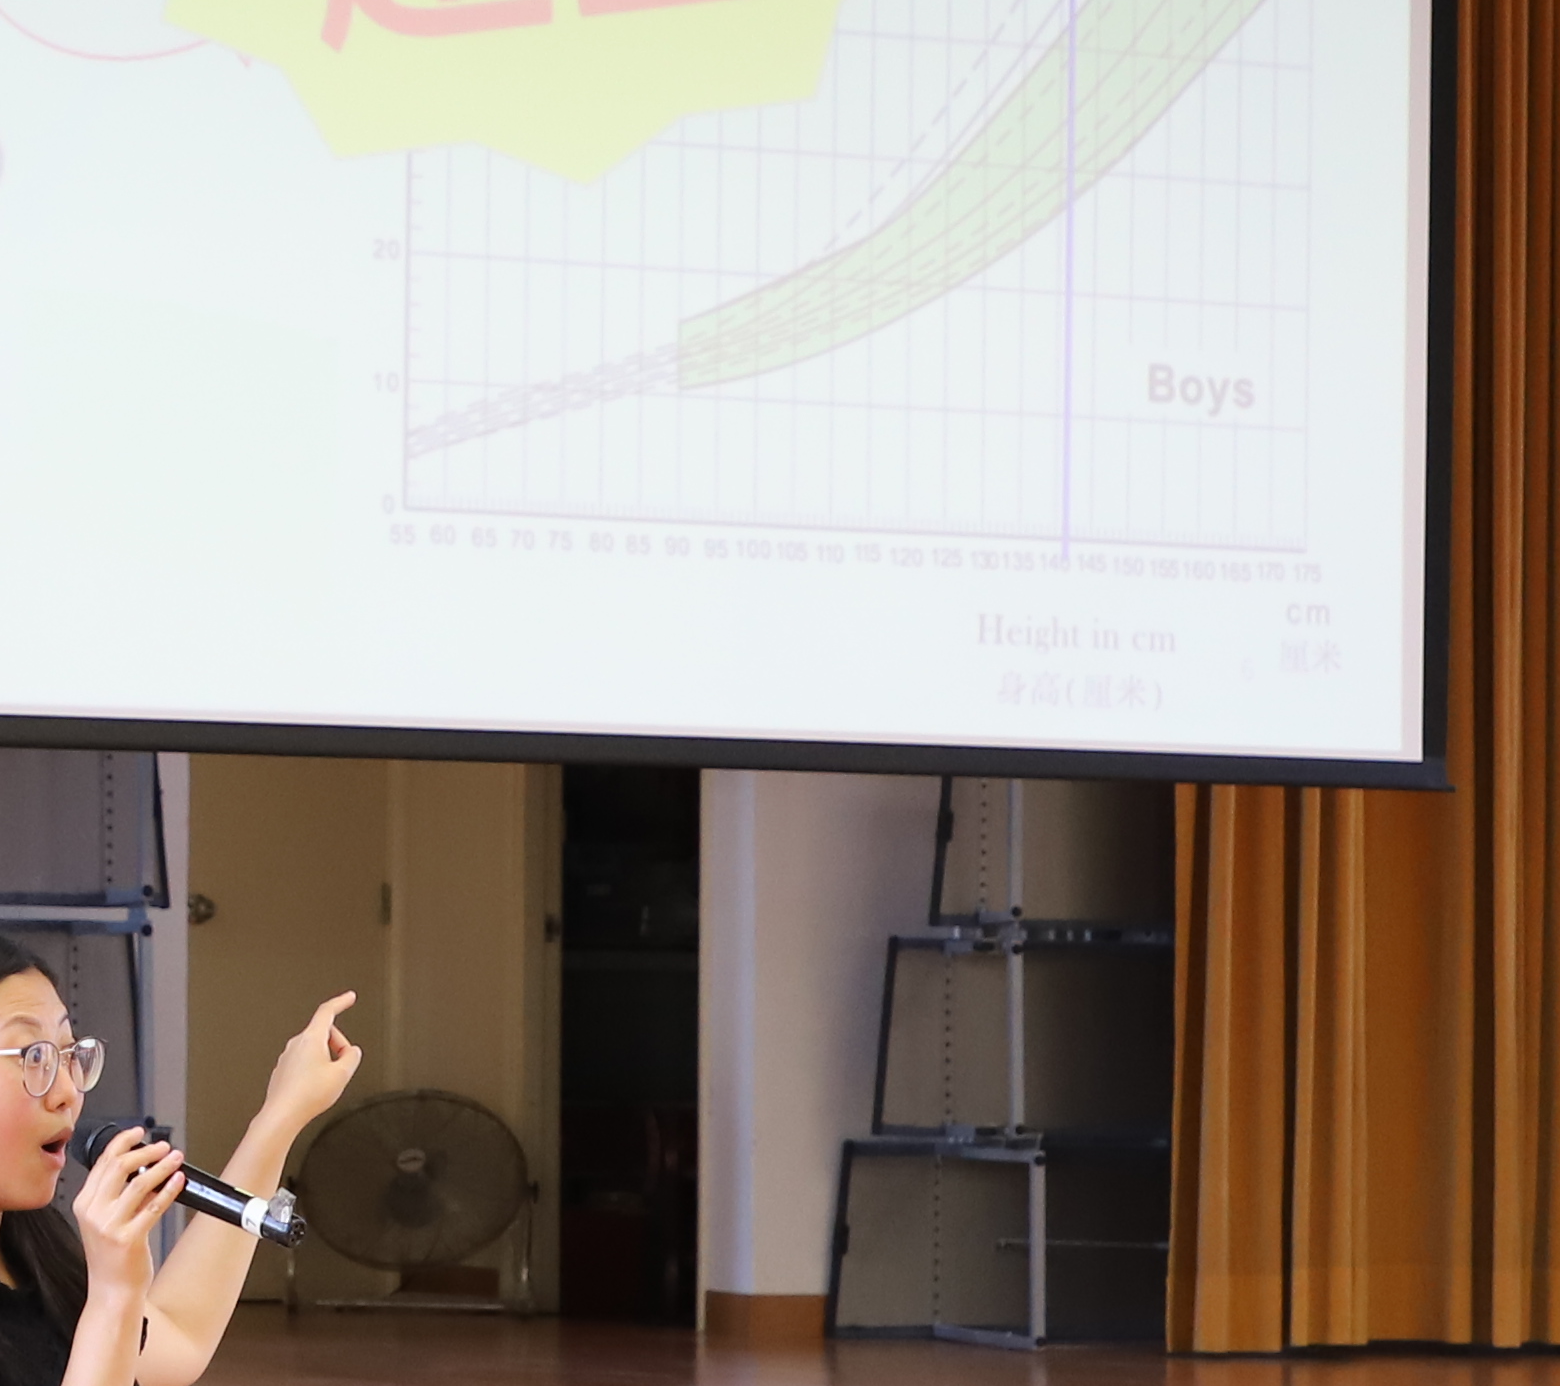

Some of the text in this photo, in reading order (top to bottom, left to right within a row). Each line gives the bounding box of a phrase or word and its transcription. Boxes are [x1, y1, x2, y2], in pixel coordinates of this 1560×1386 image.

[372, 235, 400, 262] 20
[373, 369, 400, 393] 10
[1148, 363, 1256, 418] Boys
[510, 528, 537, 552] 70
[548, 529, 574, 552] 75
[1285, 601, 1332, 627] cm
[978, 612, 1178, 655] Height in cm
